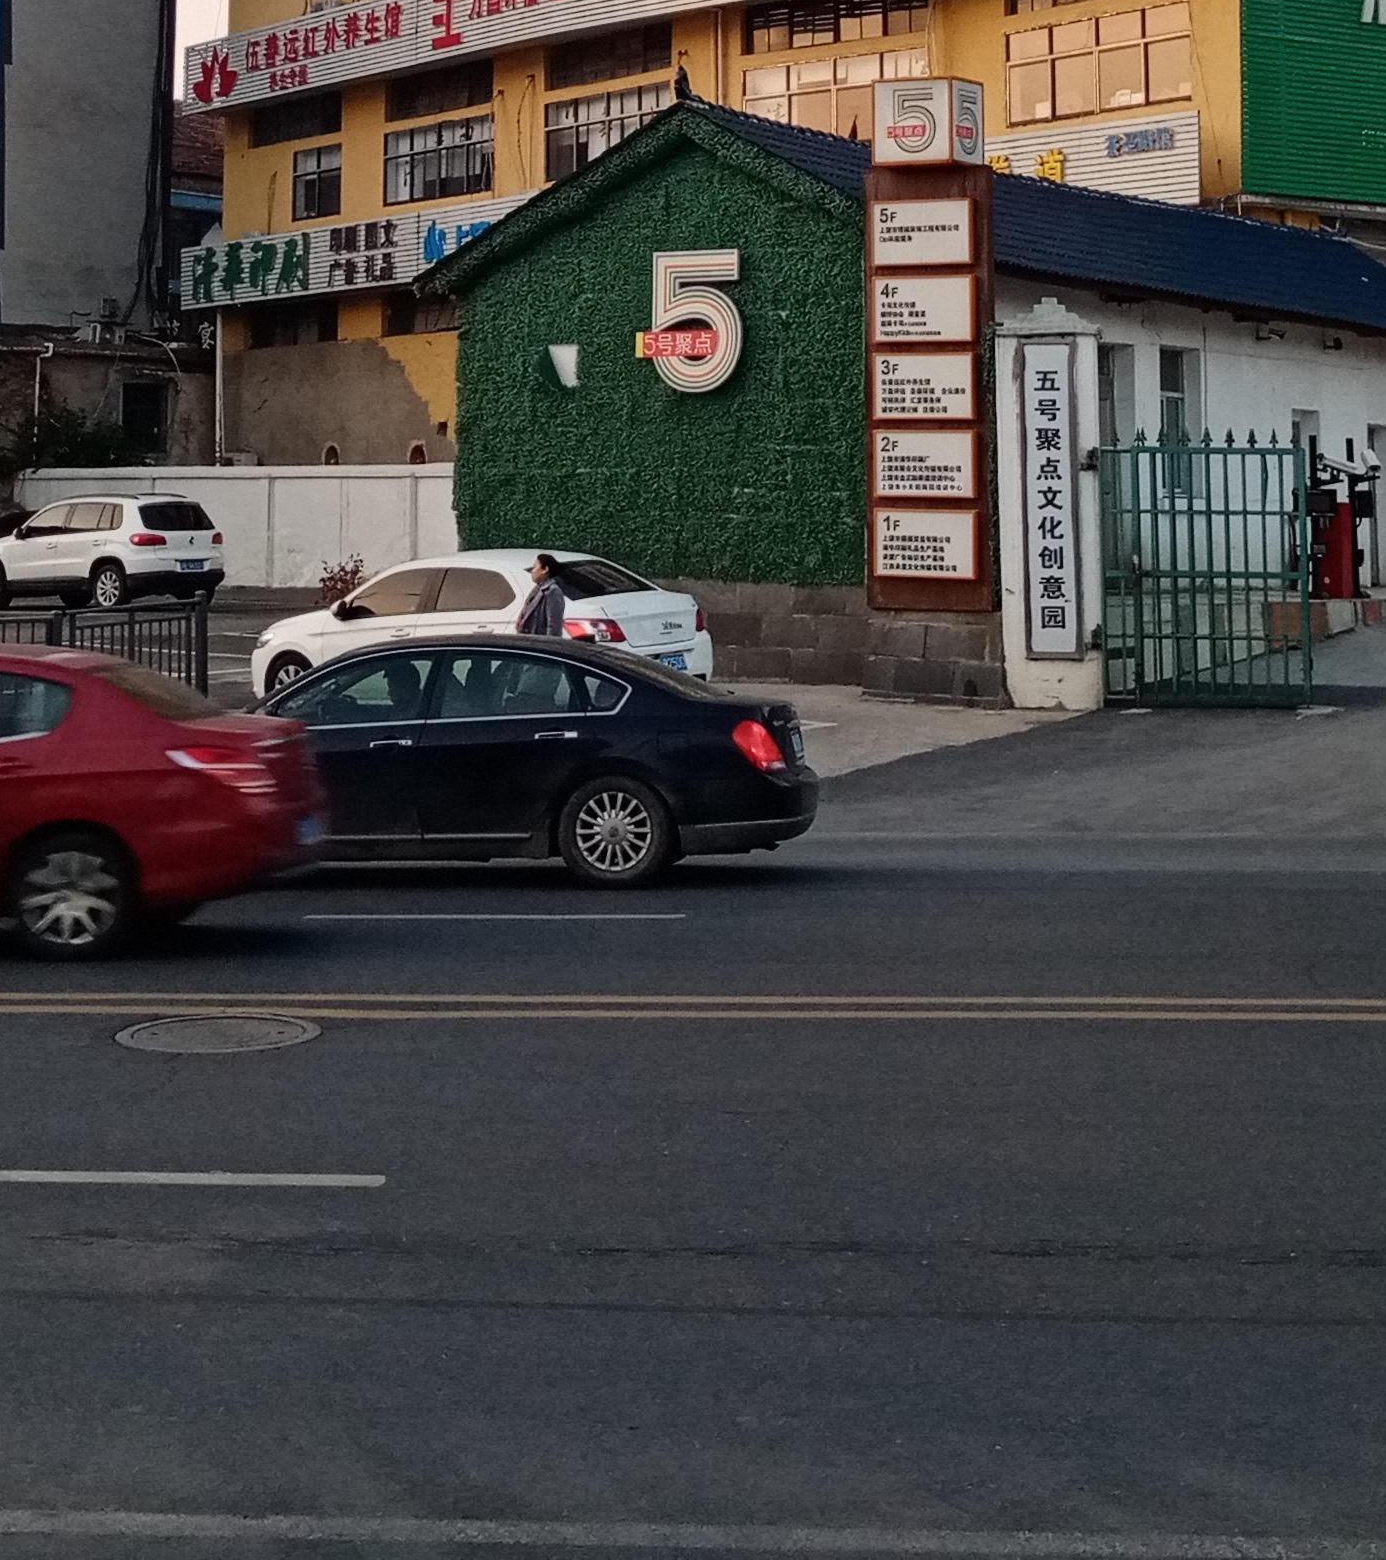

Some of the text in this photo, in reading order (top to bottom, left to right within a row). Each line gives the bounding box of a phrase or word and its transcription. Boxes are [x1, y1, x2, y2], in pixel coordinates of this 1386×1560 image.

[245, 1, 402, 73] 伍善远红外养生馆
[879, 208, 897, 223] 5F
[880, 283, 898, 298] 4F
[653, 249, 742, 392] 5
[643, 333, 713, 355] 5号聚点
[880, 360, 899, 375] 3F
[880, 436, 899, 452] 2F
[1034, 370, 1066, 630] 五号聚点文化创意园
[883, 515, 901, 531] 1F
